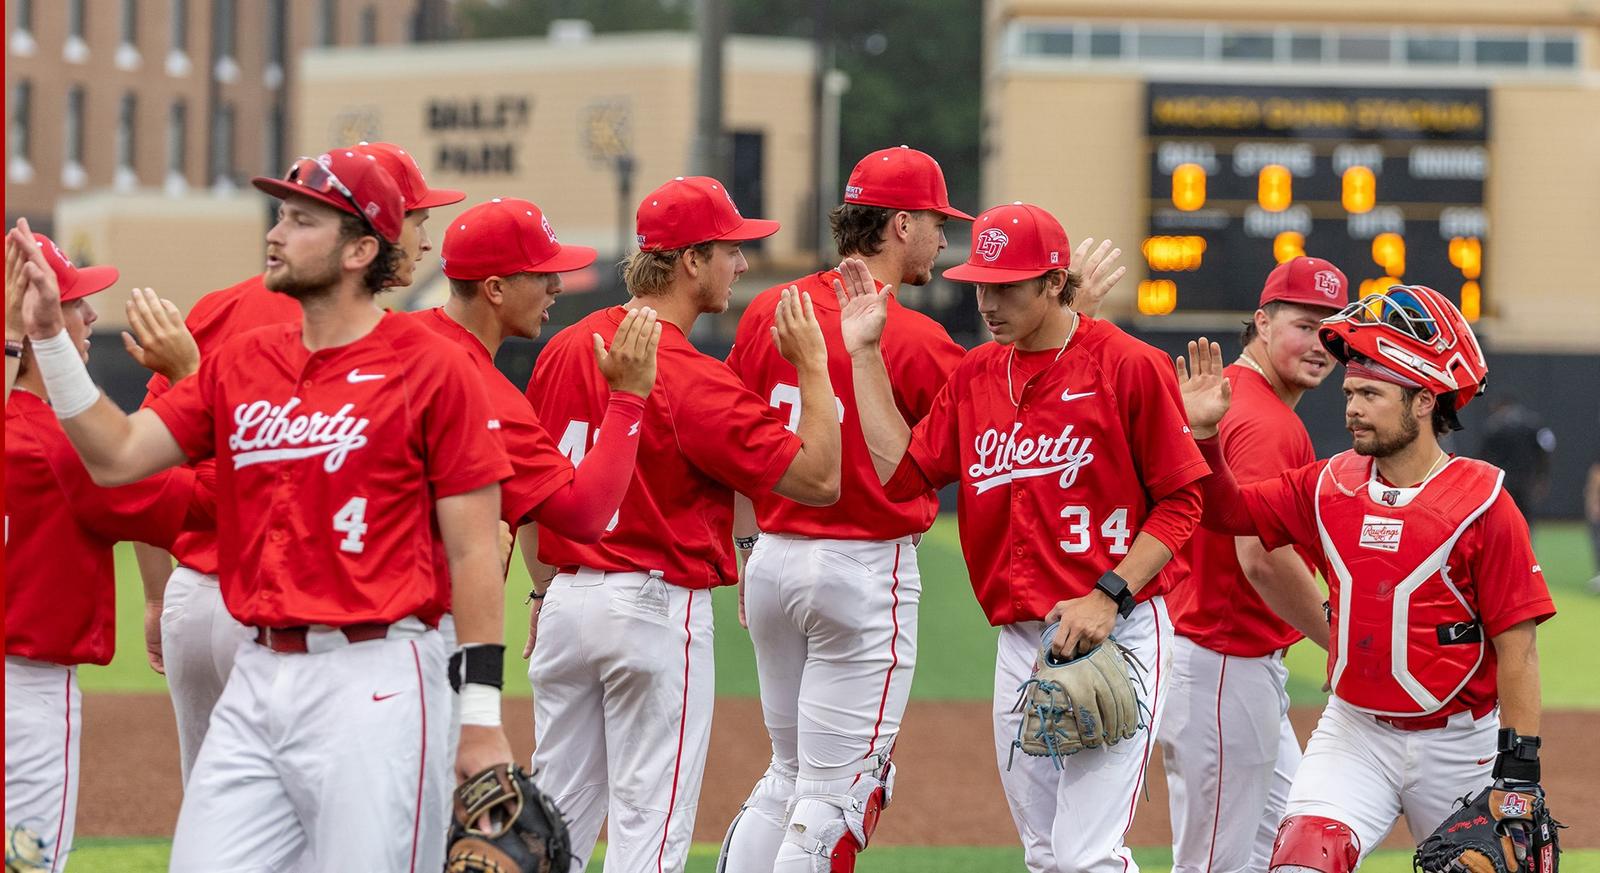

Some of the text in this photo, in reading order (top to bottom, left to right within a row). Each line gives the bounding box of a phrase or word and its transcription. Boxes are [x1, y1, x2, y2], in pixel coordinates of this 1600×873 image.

[229, 397, 369, 473] Liberty
[968, 422, 1094, 490] Liberty
[332, 496, 368, 554] 4
[1059, 505, 1130, 555] 34
